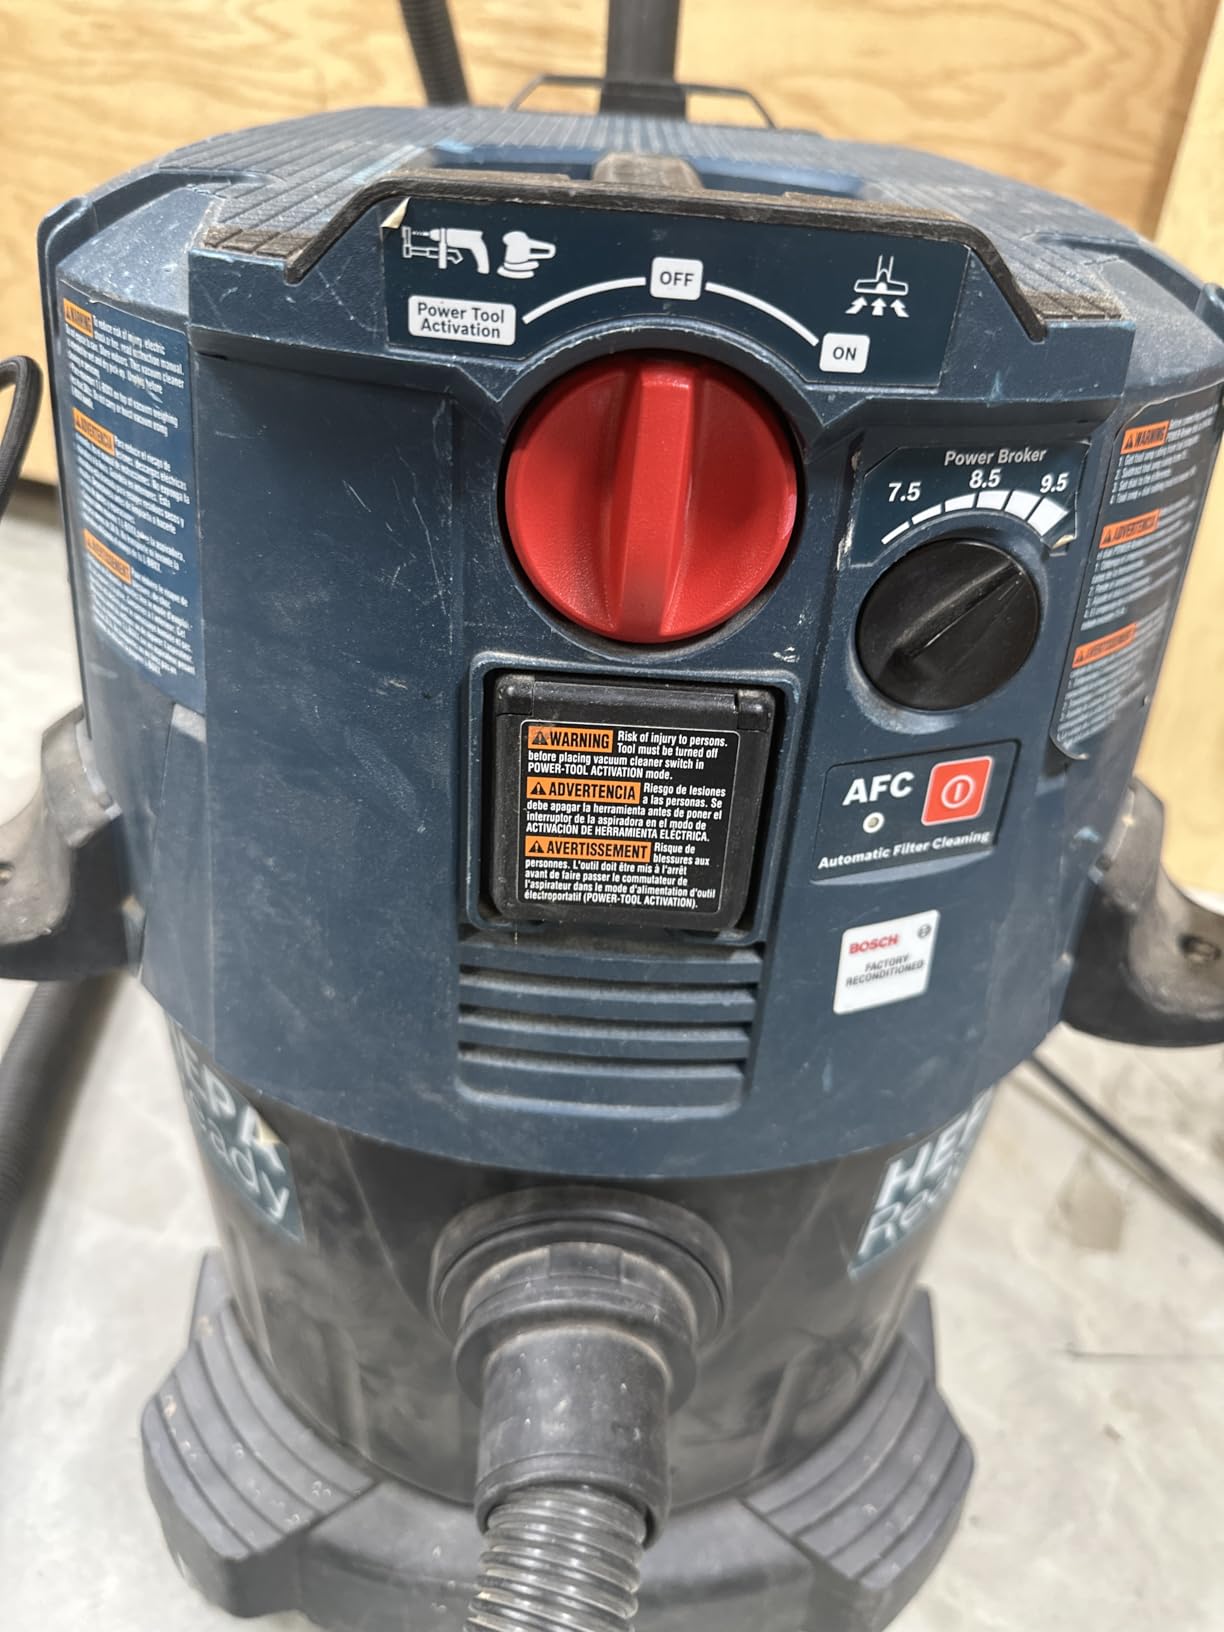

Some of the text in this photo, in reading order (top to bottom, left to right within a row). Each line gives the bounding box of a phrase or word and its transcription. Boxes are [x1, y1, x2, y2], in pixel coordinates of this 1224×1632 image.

[659, 271, 695, 287] OFF
[417, 302, 504, 324] Power Tool
[421, 318, 500, 339] Activation
[832, 347, 857, 361] ON
[944, 448, 1046, 466] Power Broker
[968, 468, 1001, 489] 8.5
[1039, 472, 1069, 493] 9.5
[888, 481, 921, 502] 7.5
[550, 731, 609, 749] WARNING
[618, 730, 728, 749] Risk of injury to persons.
[528, 750, 704, 770] before placing vacuum cleaner switch in
[617, 742, 718, 758] Tool must be turned off
[528, 761, 673, 780] POWER-TOOL ACTIVATION mode.
[549, 781, 636, 801] ADVERTENCIA
[644, 782, 726, 797] Riesgo de lesiones
[842, 771, 915, 806] AFC
[527, 799, 722, 820] debe apagar la herramienta antes de poner el
[642, 795, 722, 810] a las personas. Se
[527, 811, 706, 830] interruptor de la aspiradora en el modo de
[526, 820, 710, 842] ACTIVACIÓN DE HERRAMIENTA ELÉCTRICA.
[547, 839, 648, 860] AVERTISSEMENT
[654, 842, 695, 855] Risque de
[817, 831, 991, 870] Automatic Filter Cleaning
[526, 858, 687, 875] personnes. L'outil doit être mis à l'arrêt
[653, 853, 710, 866] blessures aux
[525, 869, 688, 886] avant de faire passer le commutateur de
[524, 888, 698, 909] électroportatif (POWER-TOOL ACTIVATION).
[525, 879, 715, 899] l'aspirateur dans le mode d'alimentation d'outil
[848, 934, 898, 955] BOSCH
[846, 960, 924, 987] RECONDITIONED
[864, 954, 909, 973] FACTORY
